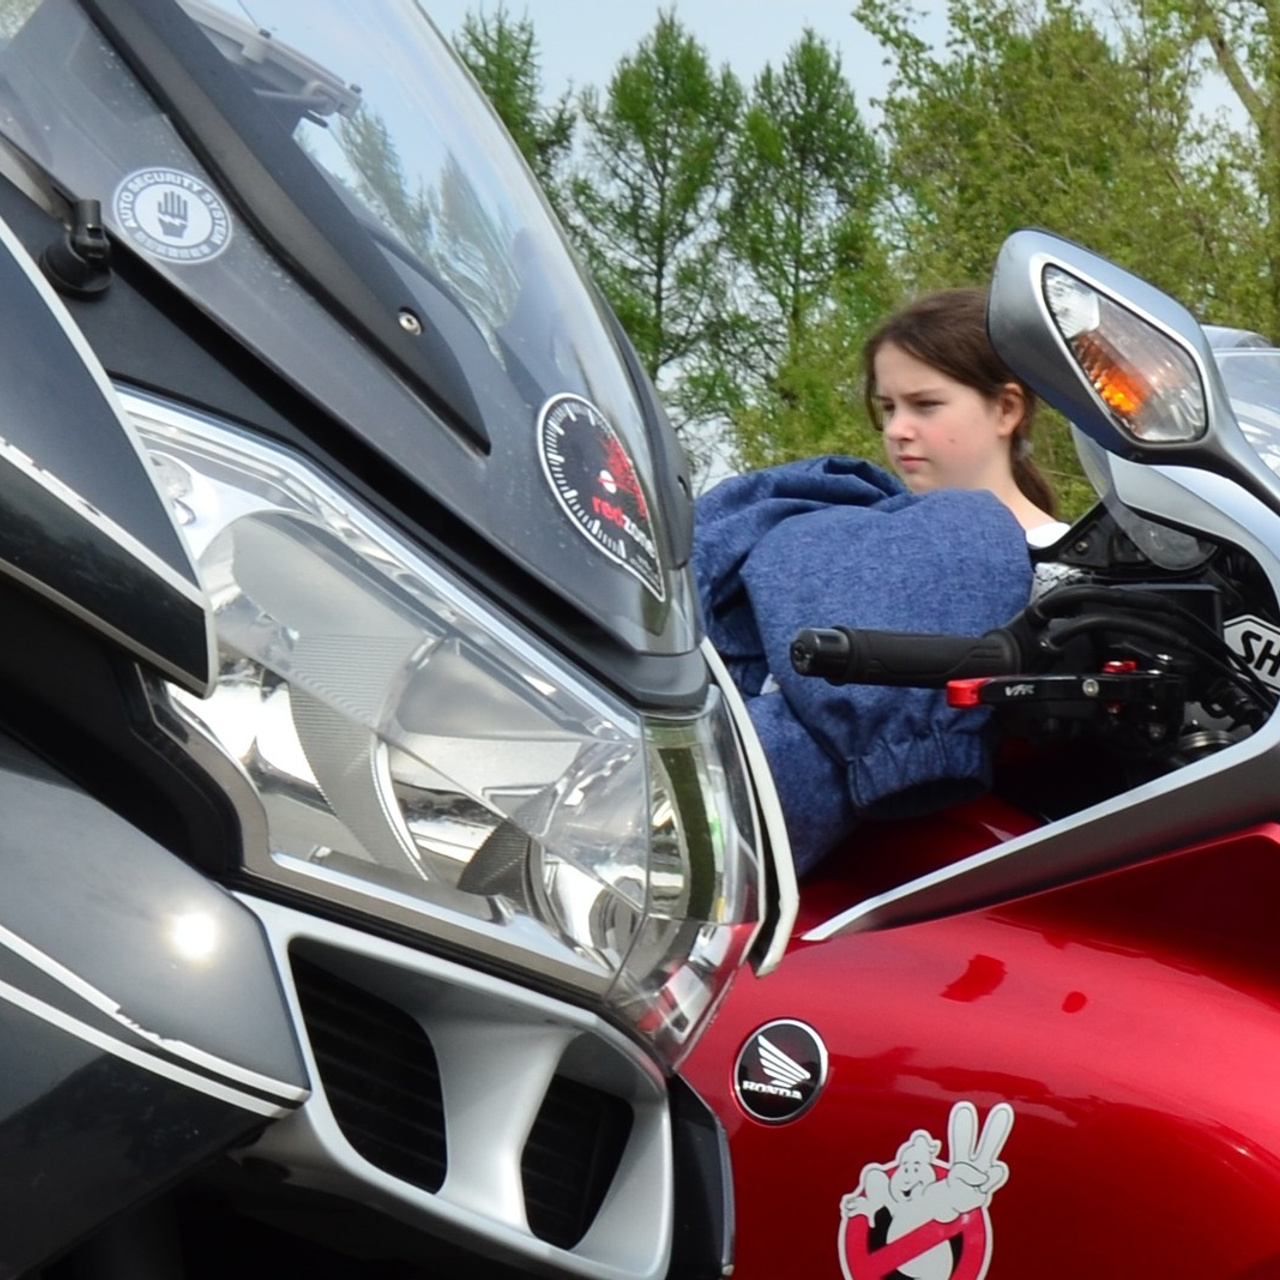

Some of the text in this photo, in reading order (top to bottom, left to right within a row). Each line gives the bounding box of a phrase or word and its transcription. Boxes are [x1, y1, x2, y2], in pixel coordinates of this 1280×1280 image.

[127, 172, 202, 193] SECURITY
[120, 191, 138, 228] AUTO
[201, 192, 226, 245] SYSTEM
[742, 1080, 803, 1100] HONDA
